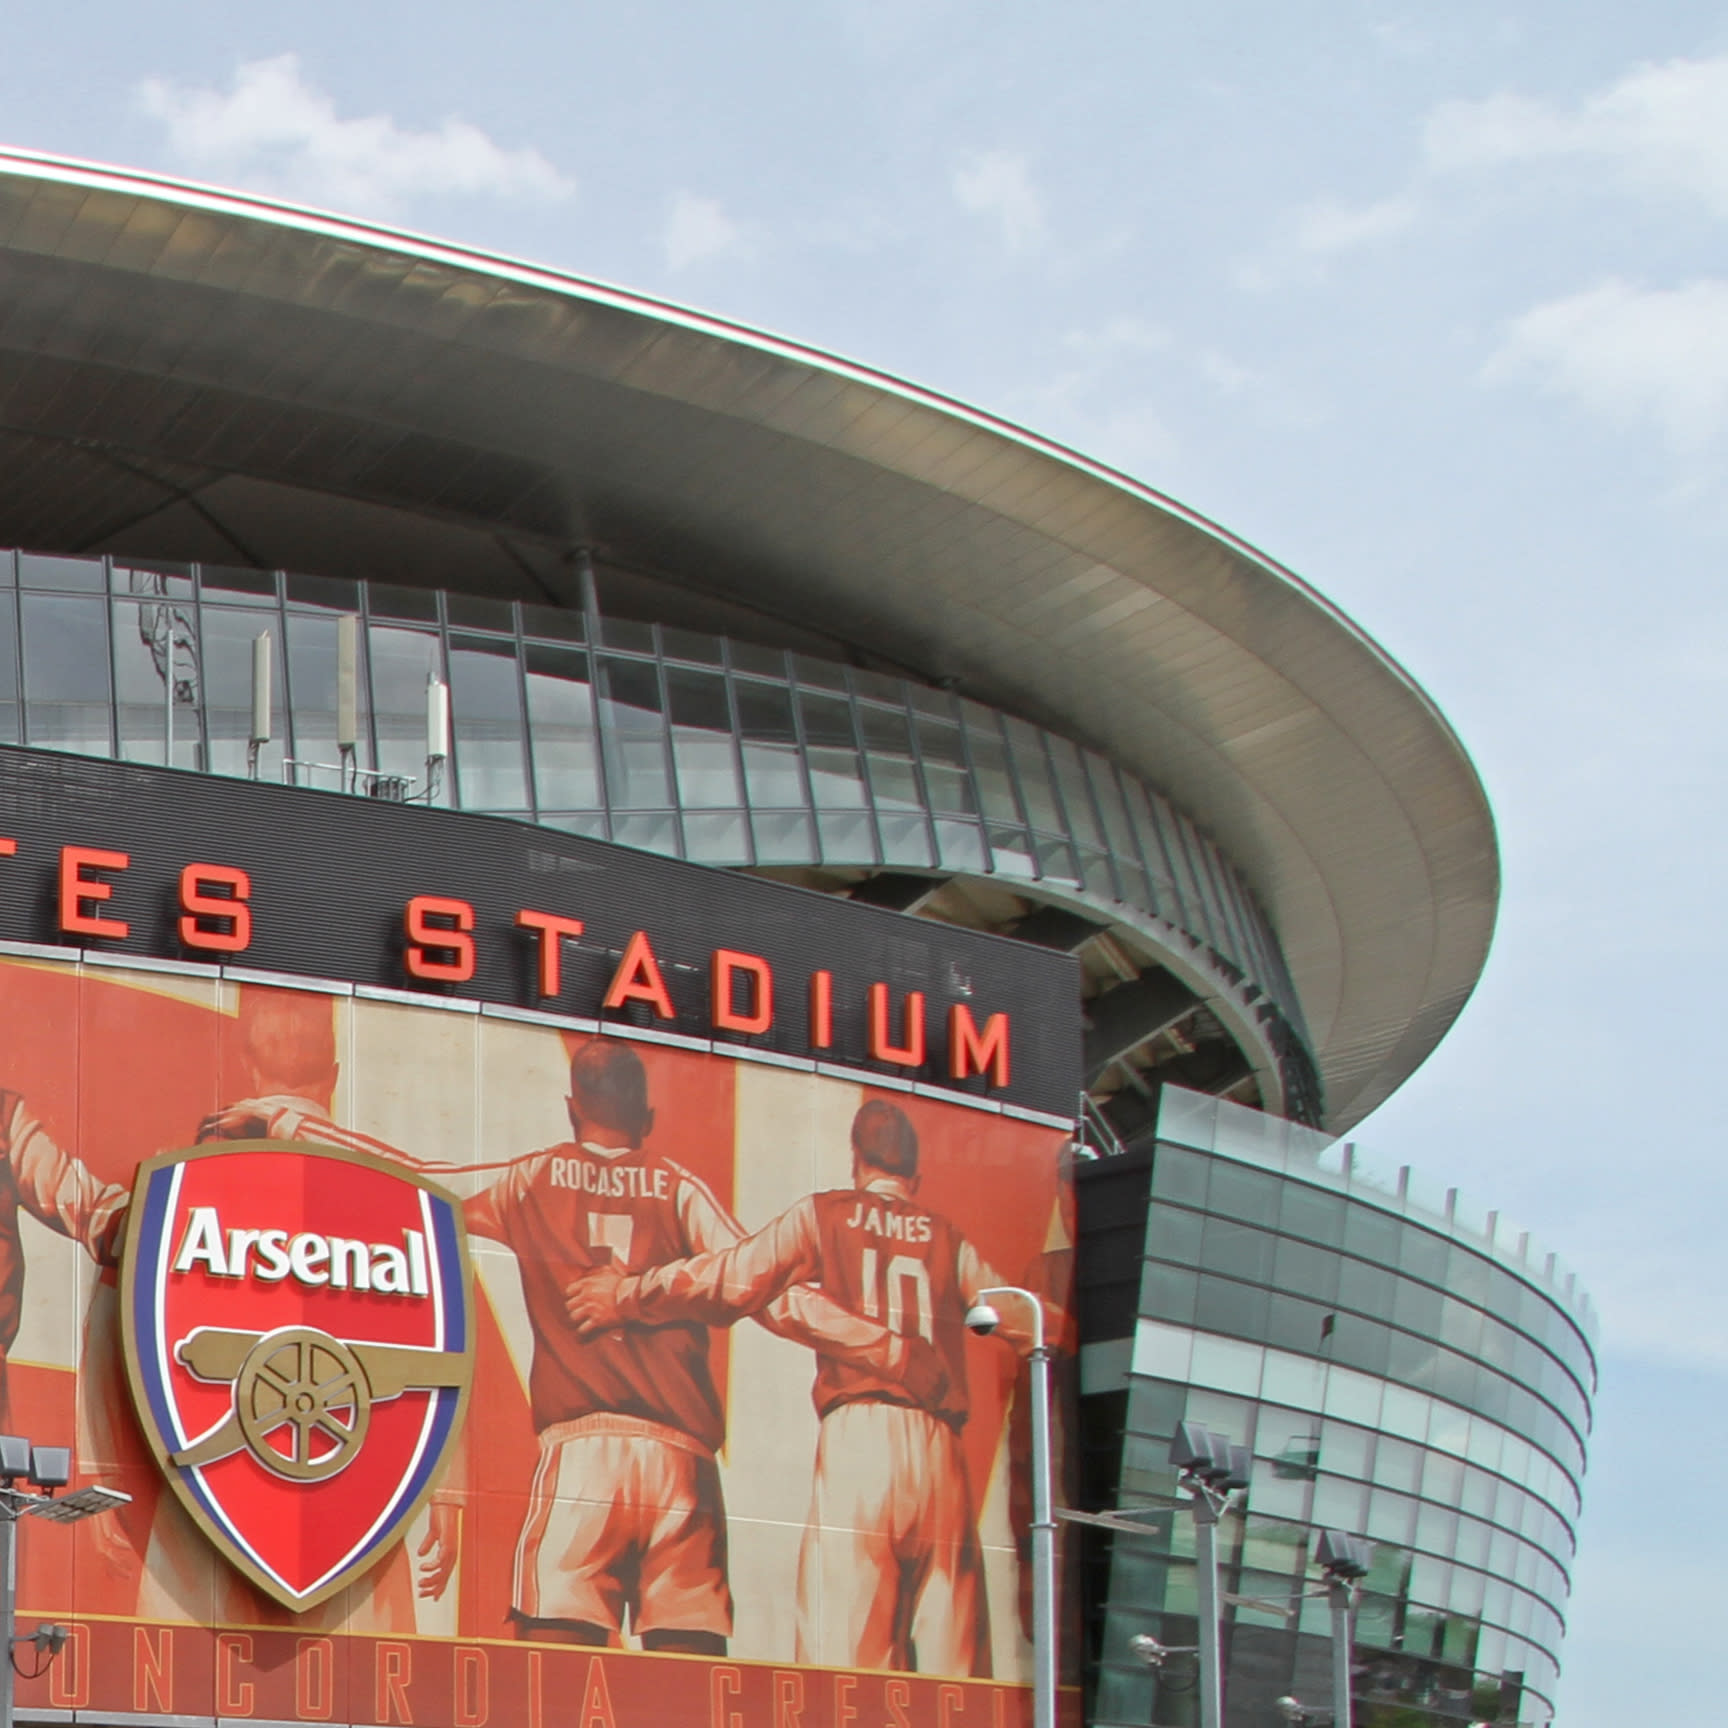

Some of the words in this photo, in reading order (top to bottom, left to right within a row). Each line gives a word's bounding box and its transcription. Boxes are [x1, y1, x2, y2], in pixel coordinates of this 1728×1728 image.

[404, 894, 1012, 1089] STADIUM
[550, 1156, 670, 1202] ROCASTLE
[846, 1202, 932, 1244] JAMES
[174, 1206, 428, 1297] Arsenal
[860, 1248, 932, 1345] 10
